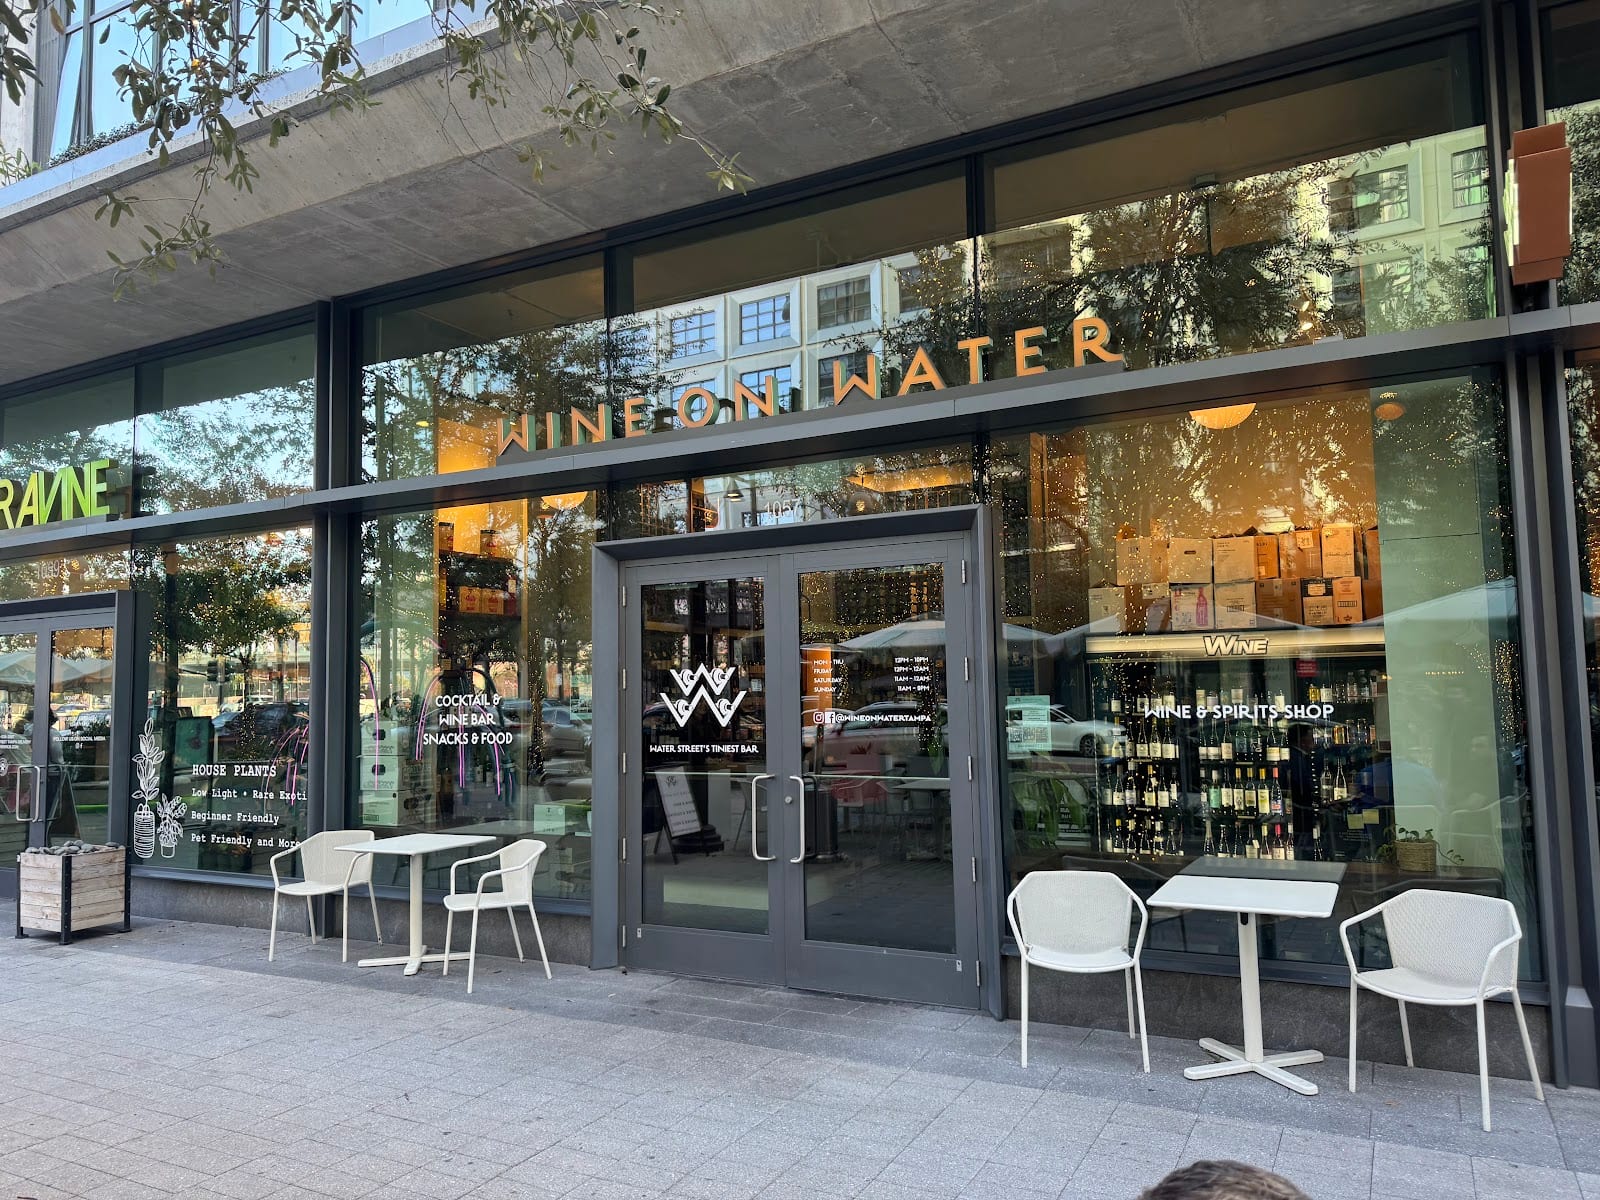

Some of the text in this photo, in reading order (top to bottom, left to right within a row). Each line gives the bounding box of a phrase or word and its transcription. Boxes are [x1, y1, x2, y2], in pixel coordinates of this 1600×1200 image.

[496, 317, 1123, 457] WINE ON WATER
[764, 498, 801, 519] 1057
[1203, 635, 1268, 656] WINE
[435, 693, 502, 707] COCKTAIL &
[835, 713, 932, 723] @WINEONWATERTAMPA
[1144, 704, 1335, 719] WINE & SPIRITS SHOP
[439, 712, 496, 726] WINE BAR
[423, 731, 513, 745] SNACKS & FOOD
[649, 744, 759, 753] WATER STREET'S TINIEST BAR
[192, 764, 277, 777] HOUSE PLANTS
[191, 788, 308, 801] Low Light Rare Exoti
[191, 811, 280, 825] Beginner Friendly
[191, 833, 206, 842] Pet
[211, 834, 252, 848] Friendly
[257, 838, 274, 847] and
